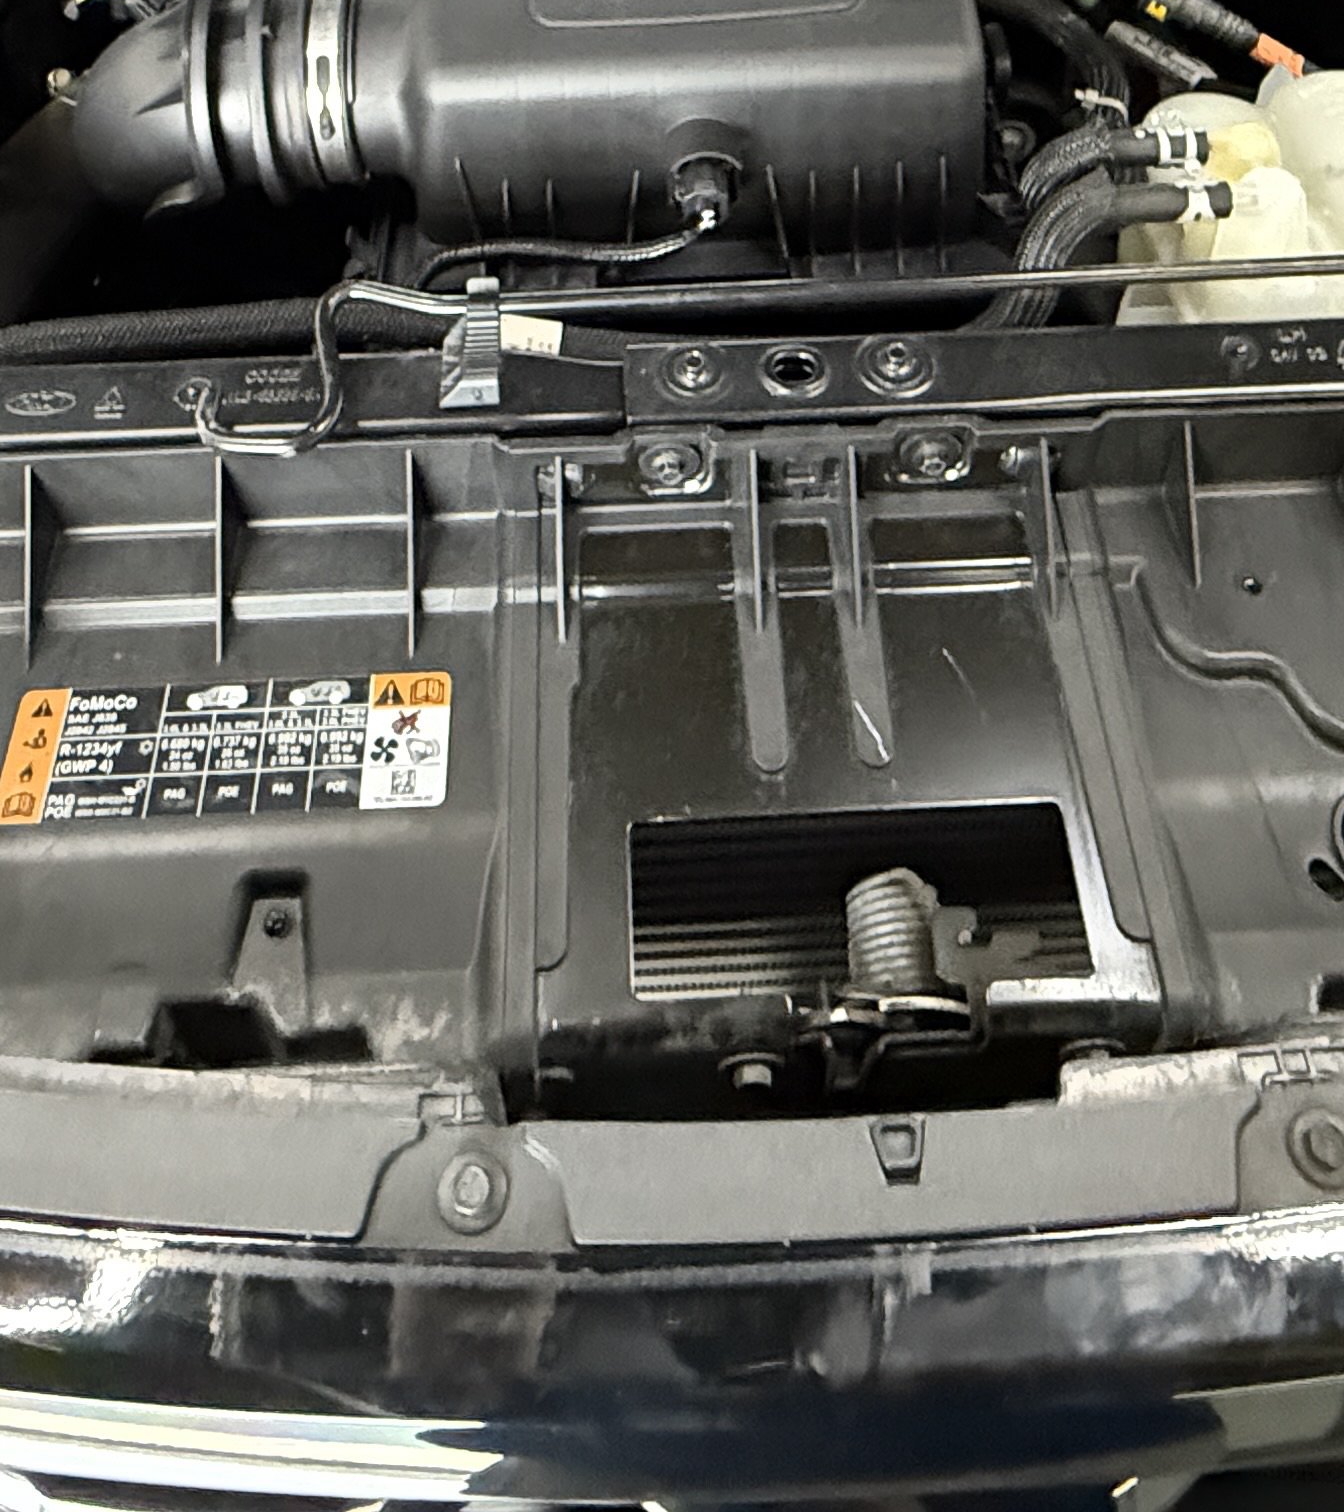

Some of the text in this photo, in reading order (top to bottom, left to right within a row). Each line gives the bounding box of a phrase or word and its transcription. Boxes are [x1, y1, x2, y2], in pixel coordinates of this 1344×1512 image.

[69, 694, 138, 711] FoMoCo
[59, 740, 123, 758] R-1234yf
[55, 759, 114, 776] (GWP 4)
[164, 788, 186, 800] PAG
[217, 785, 240, 798] POE
[272, 782, 294, 796] PAG
[47, 793, 76, 808] PAG
[44, 806, 73, 819] POE
